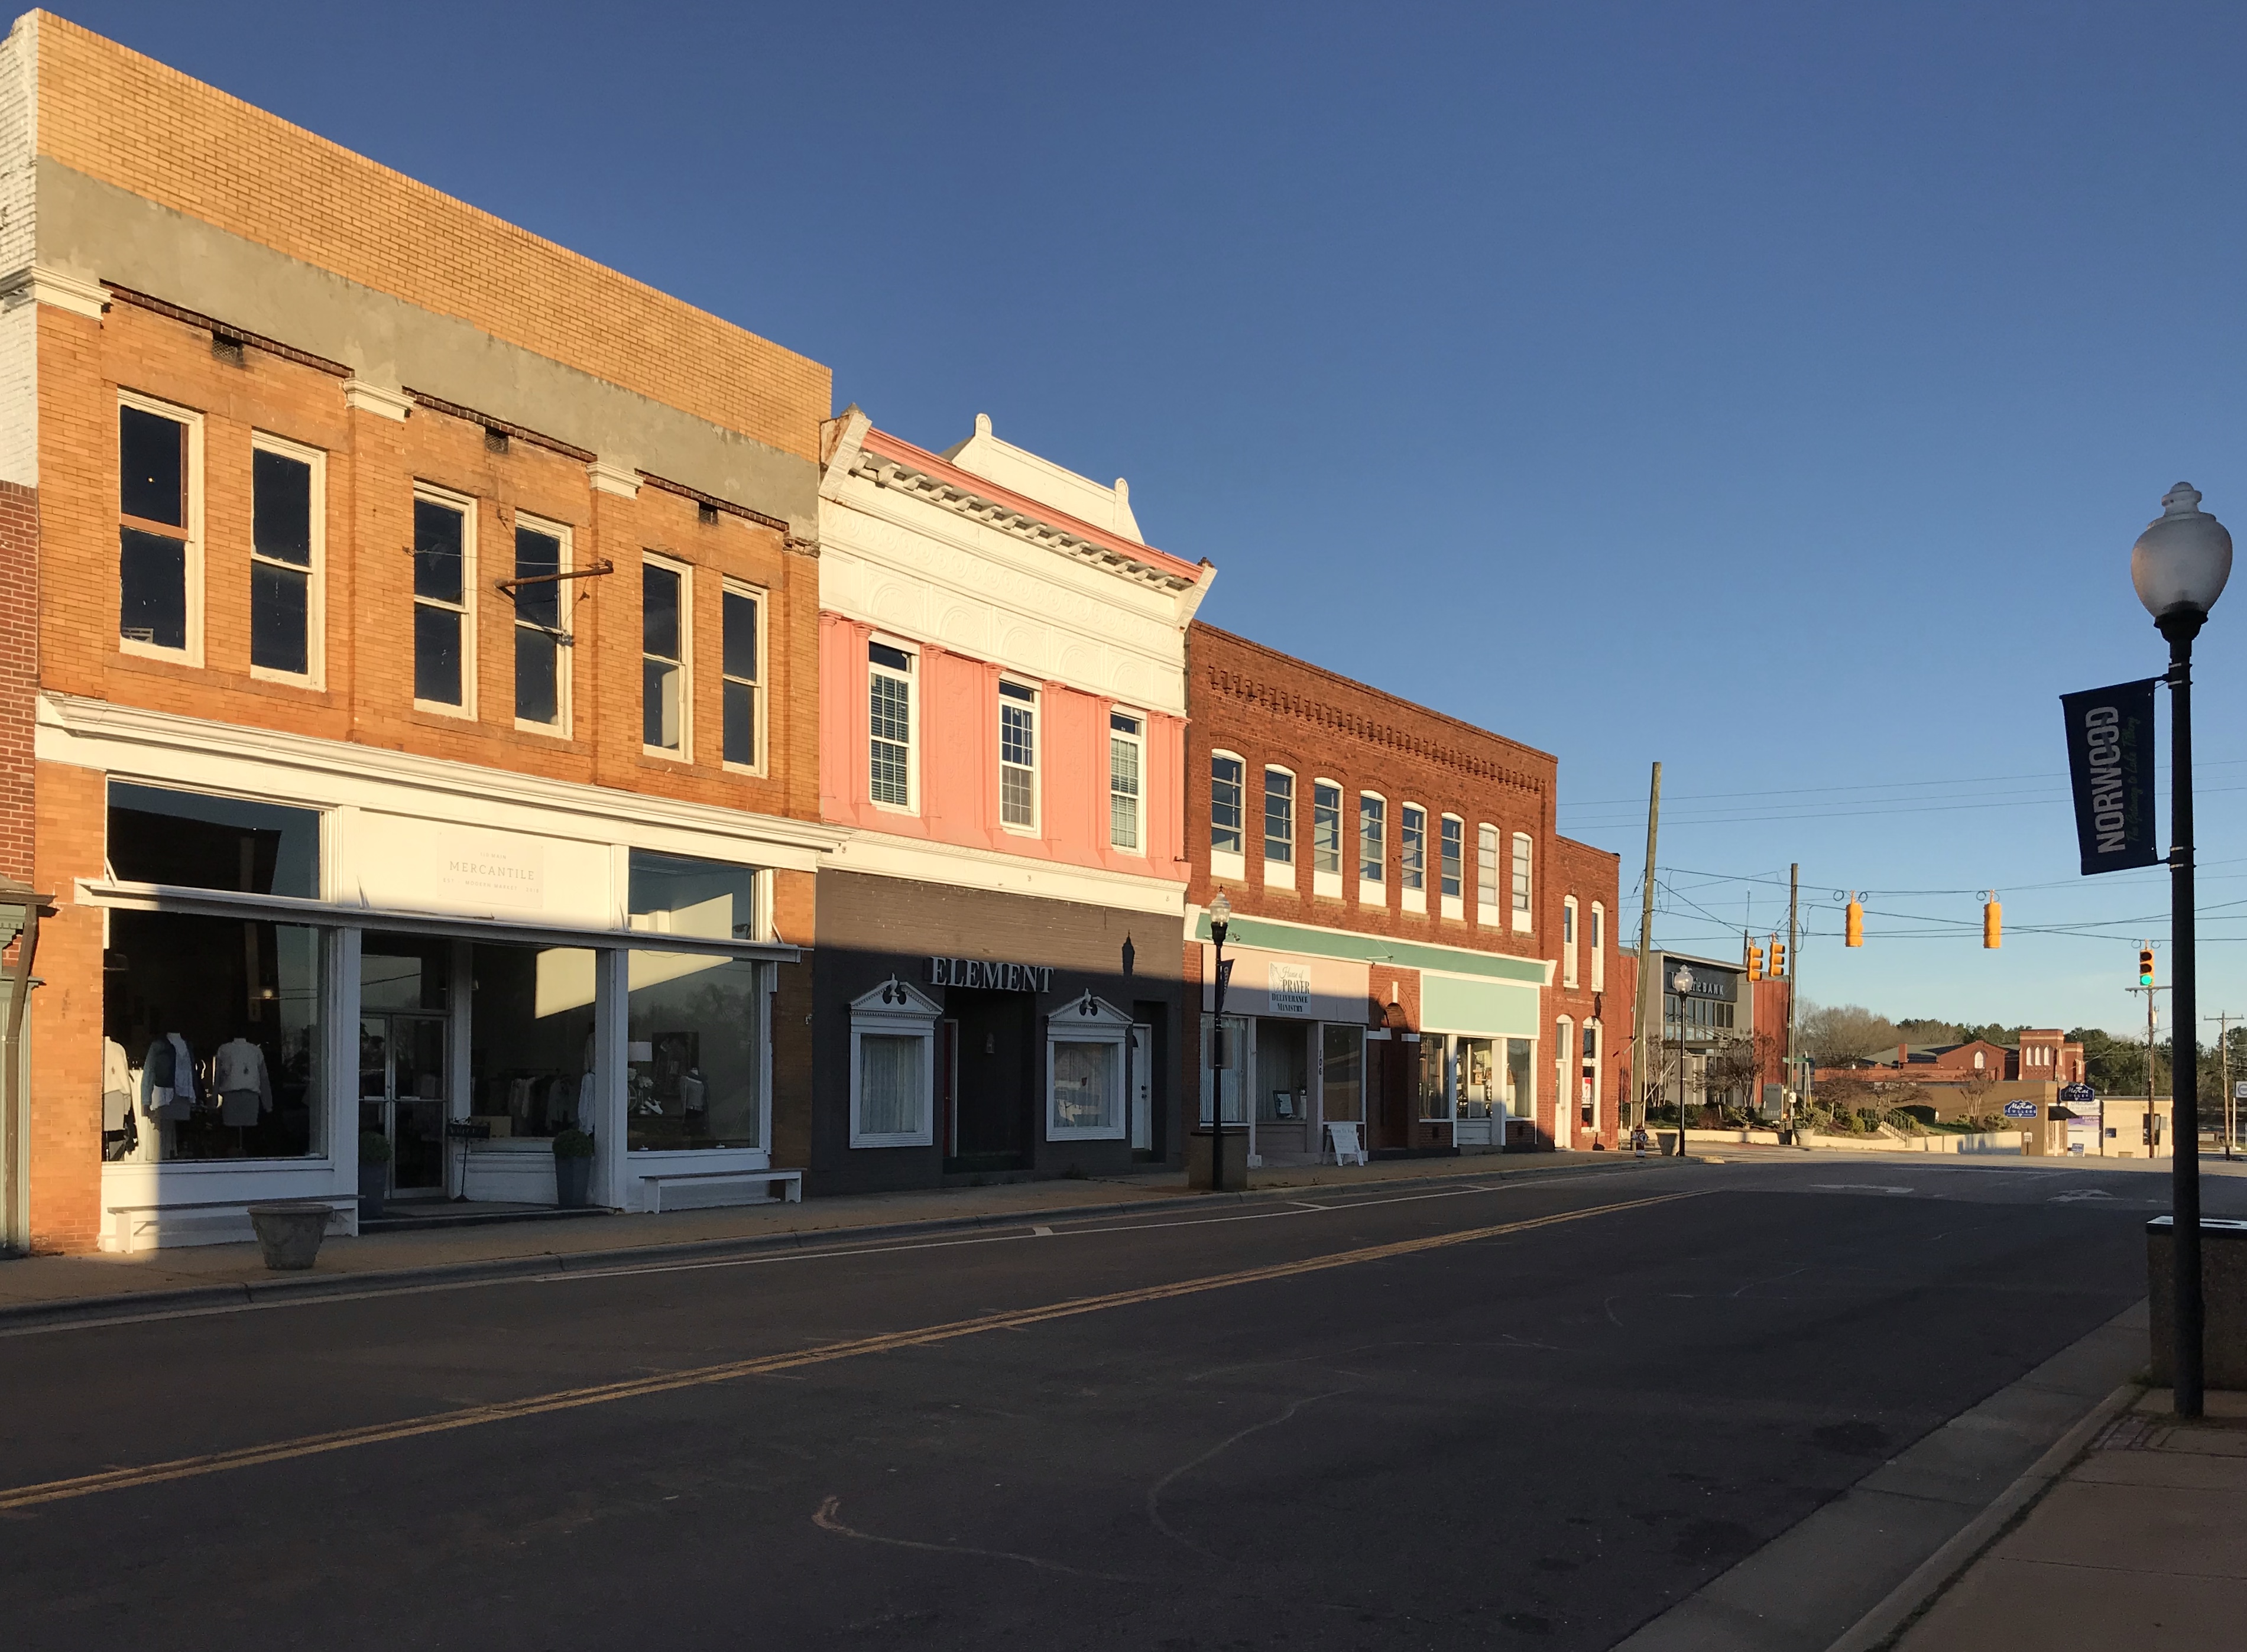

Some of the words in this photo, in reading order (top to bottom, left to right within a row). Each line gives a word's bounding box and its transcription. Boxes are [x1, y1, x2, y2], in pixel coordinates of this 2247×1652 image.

[2086, 706, 2126, 853] NORWOOD
[449, 861, 534, 880] MERCANTILE
[930, 956, 1054, 993] ELEMENT
[1279, 965, 1298, 979] House
[1298, 969, 1304, 981] of
[1283, 979, 1310, 994] PRAYER
[1703, 982, 1724, 995] BANK
[1272, 993, 1308, 1003] DELIVERANCE
[1277, 1002, 1303, 1012] MINISTRY
